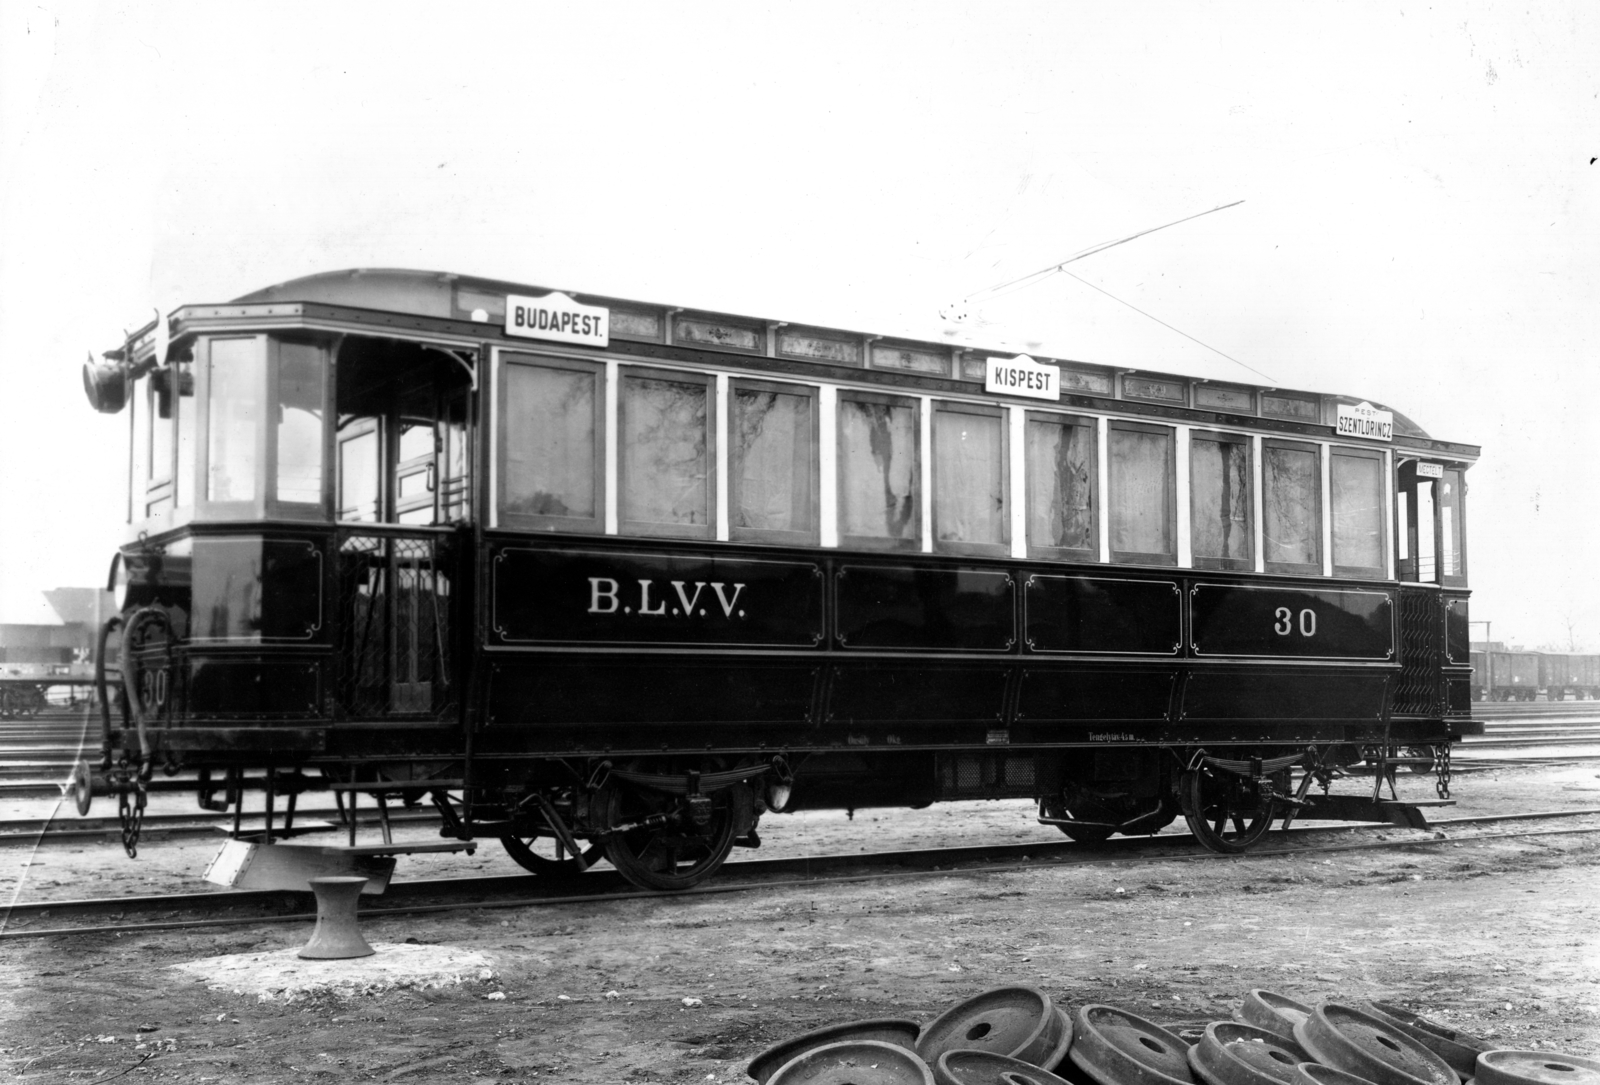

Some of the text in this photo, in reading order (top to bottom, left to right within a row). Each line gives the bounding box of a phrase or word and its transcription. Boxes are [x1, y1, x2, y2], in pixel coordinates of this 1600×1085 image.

[515, 305, 603, 338] BUDAPEST.
[995, 366, 1051, 391] KISPEST
[587, 576, 747, 618] B.L.V.V.
[1274, 606, 1317, 637] 30
[144, 669, 166, 709] 30
